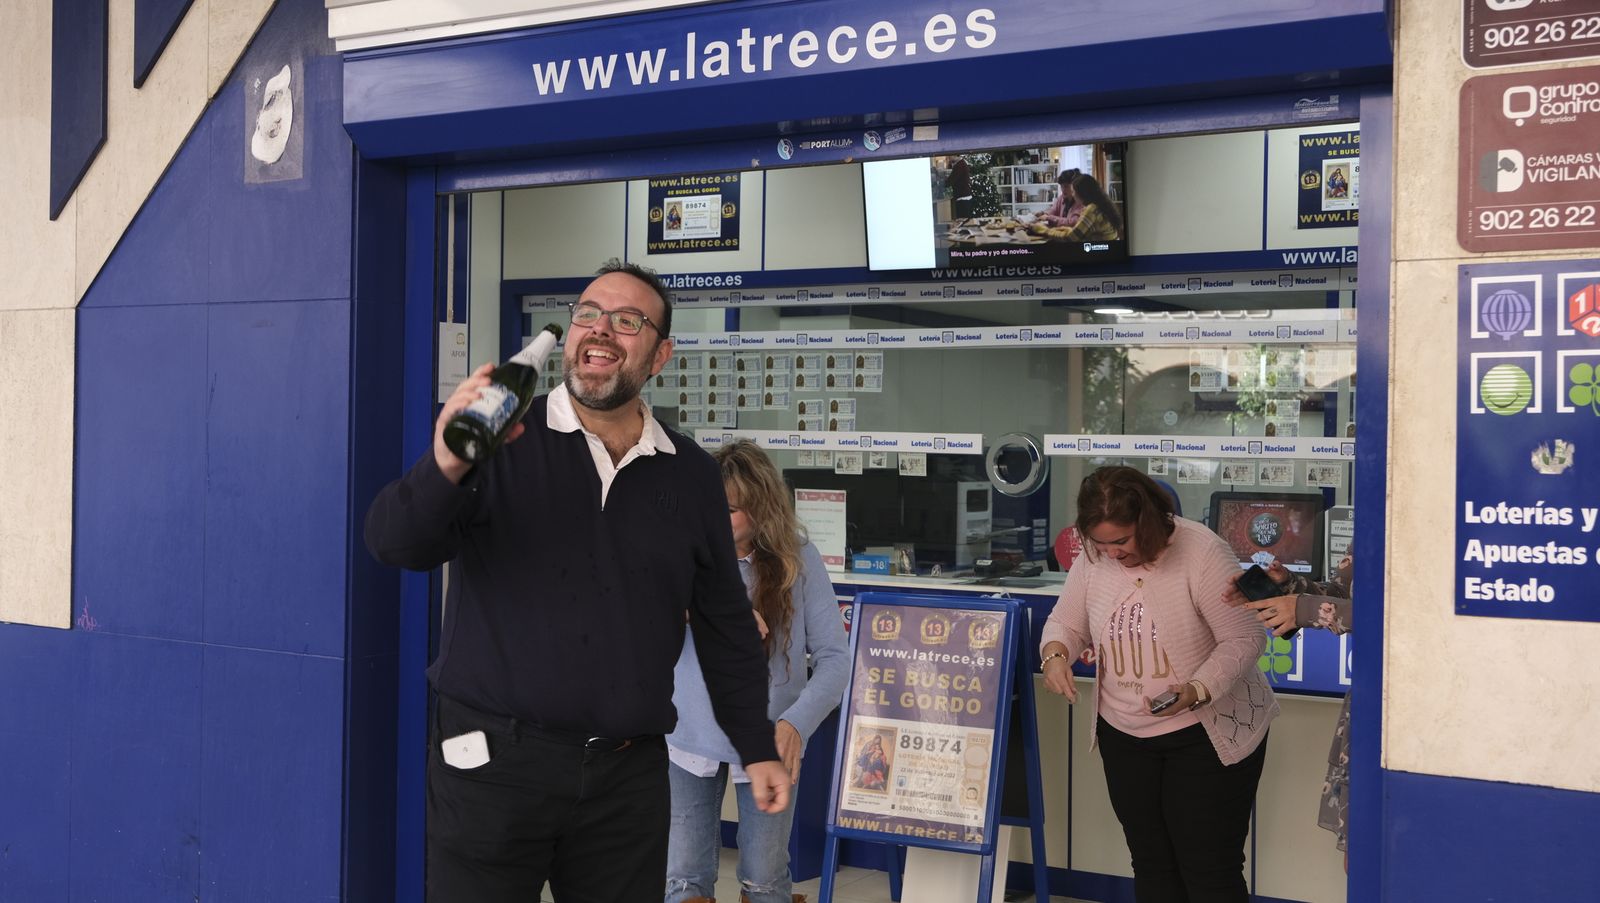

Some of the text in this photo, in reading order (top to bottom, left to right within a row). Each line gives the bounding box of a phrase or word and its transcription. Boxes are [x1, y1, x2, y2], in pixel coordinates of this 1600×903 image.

[1484, 25, 1529, 49] 902
[1534, 21, 1566, 44] 26
[1570, 17, 1600, 40] 22
[533, 8, 997, 95] www.latrece.es
[1539, 82, 1599, 103] grupo
[1539, 97, 1600, 116] contro
[1540, 115, 1577, 124] seguridad
[1302, 133, 1360, 148] www.la
[1526, 153, 1593, 167] CÁMARAS
[1305, 175, 1315, 185] 13
[1526, 165, 1600, 183] VIGILAN
[650, 175, 738, 188] www.latrece.es
[1300, 210, 1360, 223] www.la
[1480, 205, 1596, 231] 902 26 22
[648, 238, 738, 250] www.latrece.es
[971, 250, 988, 258] padre
[1282, 247, 1358, 265] www.la
[931, 265, 1062, 278] www.latrece.es
[660, 274, 743, 289] w.latrece.es
[1116, 283, 1146, 291] Nacional
[1203, 280, 1234, 288] Nacional
[1295, 276, 1327, 285] Nacional
[1035, 286, 1063, 294] Nacional
[955, 333, 982, 341] Nacional
[1201, 330, 1232, 338] Nacional
[1293, 328, 1325, 336] Nacional
[1176, 443, 1206, 451] Nacional
[1464, 500, 1599, 533] Loterías y
[1463, 539, 1588, 568] Apuestas
[1464, 577, 1555, 603] Estado
[879, 619, 893, 631] 13
[927, 623, 942, 636] 13
[869, 647, 995, 667] www.latrece.es
[868, 667, 983, 693] SE BUSCA
[1117, 681, 1144, 695] energy
[864, 688, 982, 715] EL GORDO
[900, 734, 962, 755] 89874
